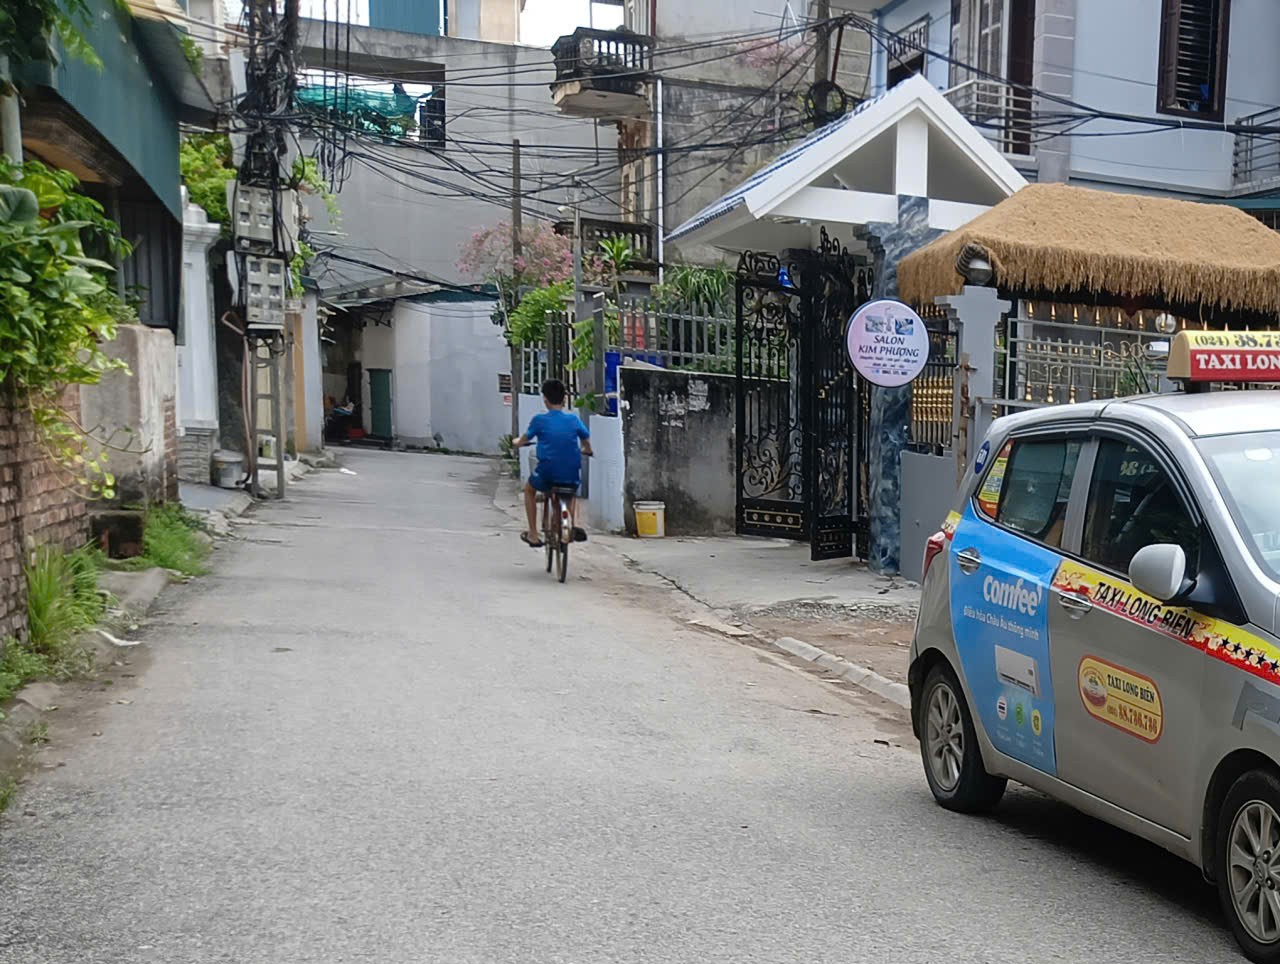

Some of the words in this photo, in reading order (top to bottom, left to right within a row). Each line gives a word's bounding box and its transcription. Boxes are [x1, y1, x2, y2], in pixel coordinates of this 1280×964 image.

[873, 334, 905, 346] SALON
[857, 344, 878, 355] KIM
[1196, 354, 1242, 370] TAXI
[1092, 581, 1124, 608] TAXI
[1121, 594, 1163, 624] LONG
[1160, 608, 1197, 639] BIÊN
[1107, 673, 1122, 691] TAXI
[1122, 680, 1139, 698] LONG
[1139, 686, 1155, 704] BIÊN
